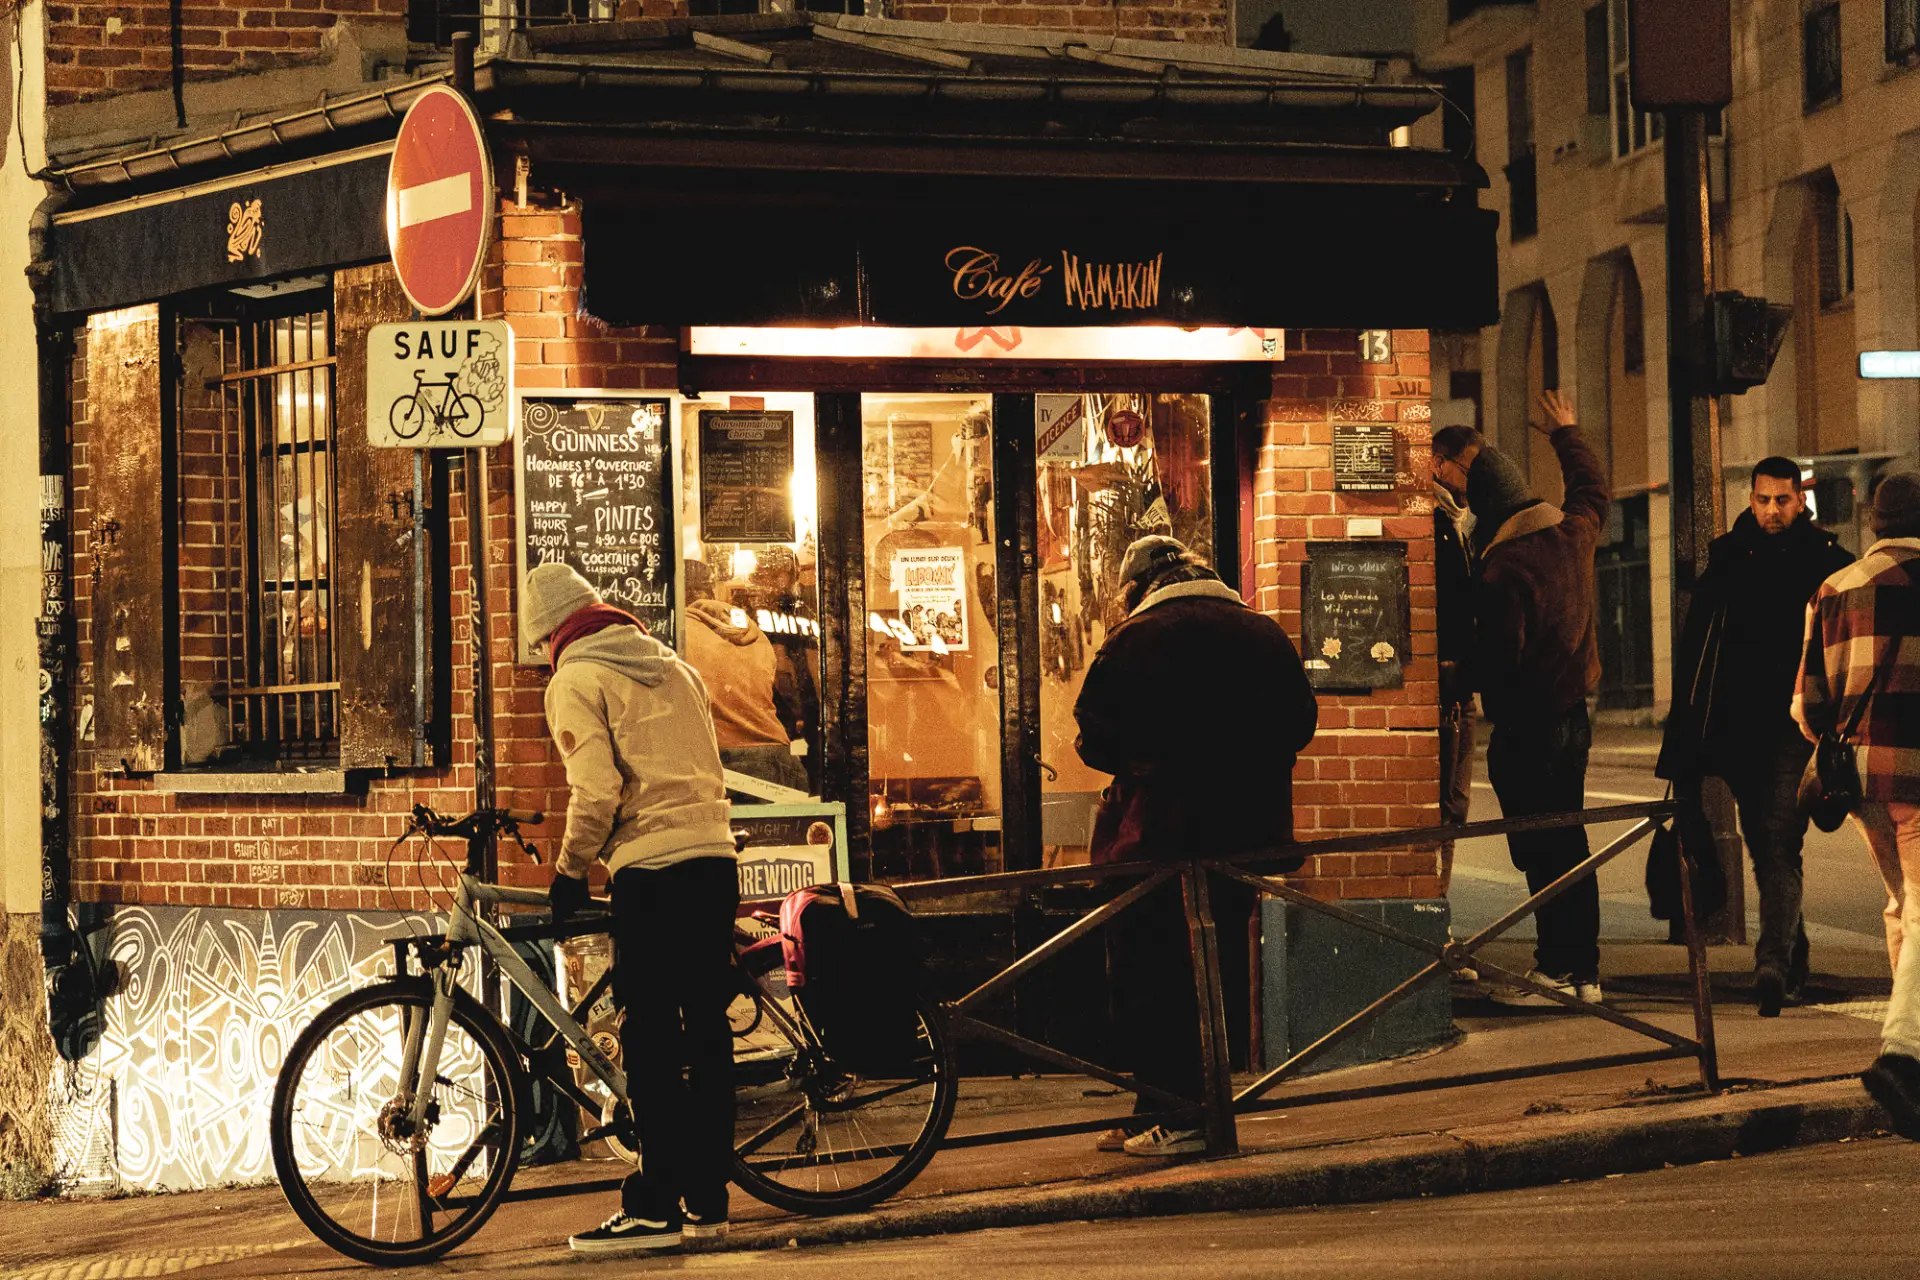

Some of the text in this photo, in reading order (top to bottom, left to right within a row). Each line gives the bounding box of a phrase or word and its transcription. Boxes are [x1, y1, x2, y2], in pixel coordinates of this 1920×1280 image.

[945, 246, 1163, 315] Café MAMAKIN
[394, 329, 481, 360] SAUF
[1358, 330, 1389, 361] 13
[710, 417, 783, 430] Consommations
[1041, 409, 1052, 422] IV
[1041, 405, 1077, 452] LICENCE
[551, 430, 639, 452] GUINNESS
[549, 474, 563, 488] DE
[615, 473, 645, 490] 1H30
[531, 501, 567, 514] HAPPY
[533, 518, 567, 531] HOURS
[594, 501, 654, 532] PINTES
[581, 550, 640, 567] COCKTAILS
[586, 567, 628, 575] CLASSIQUES
